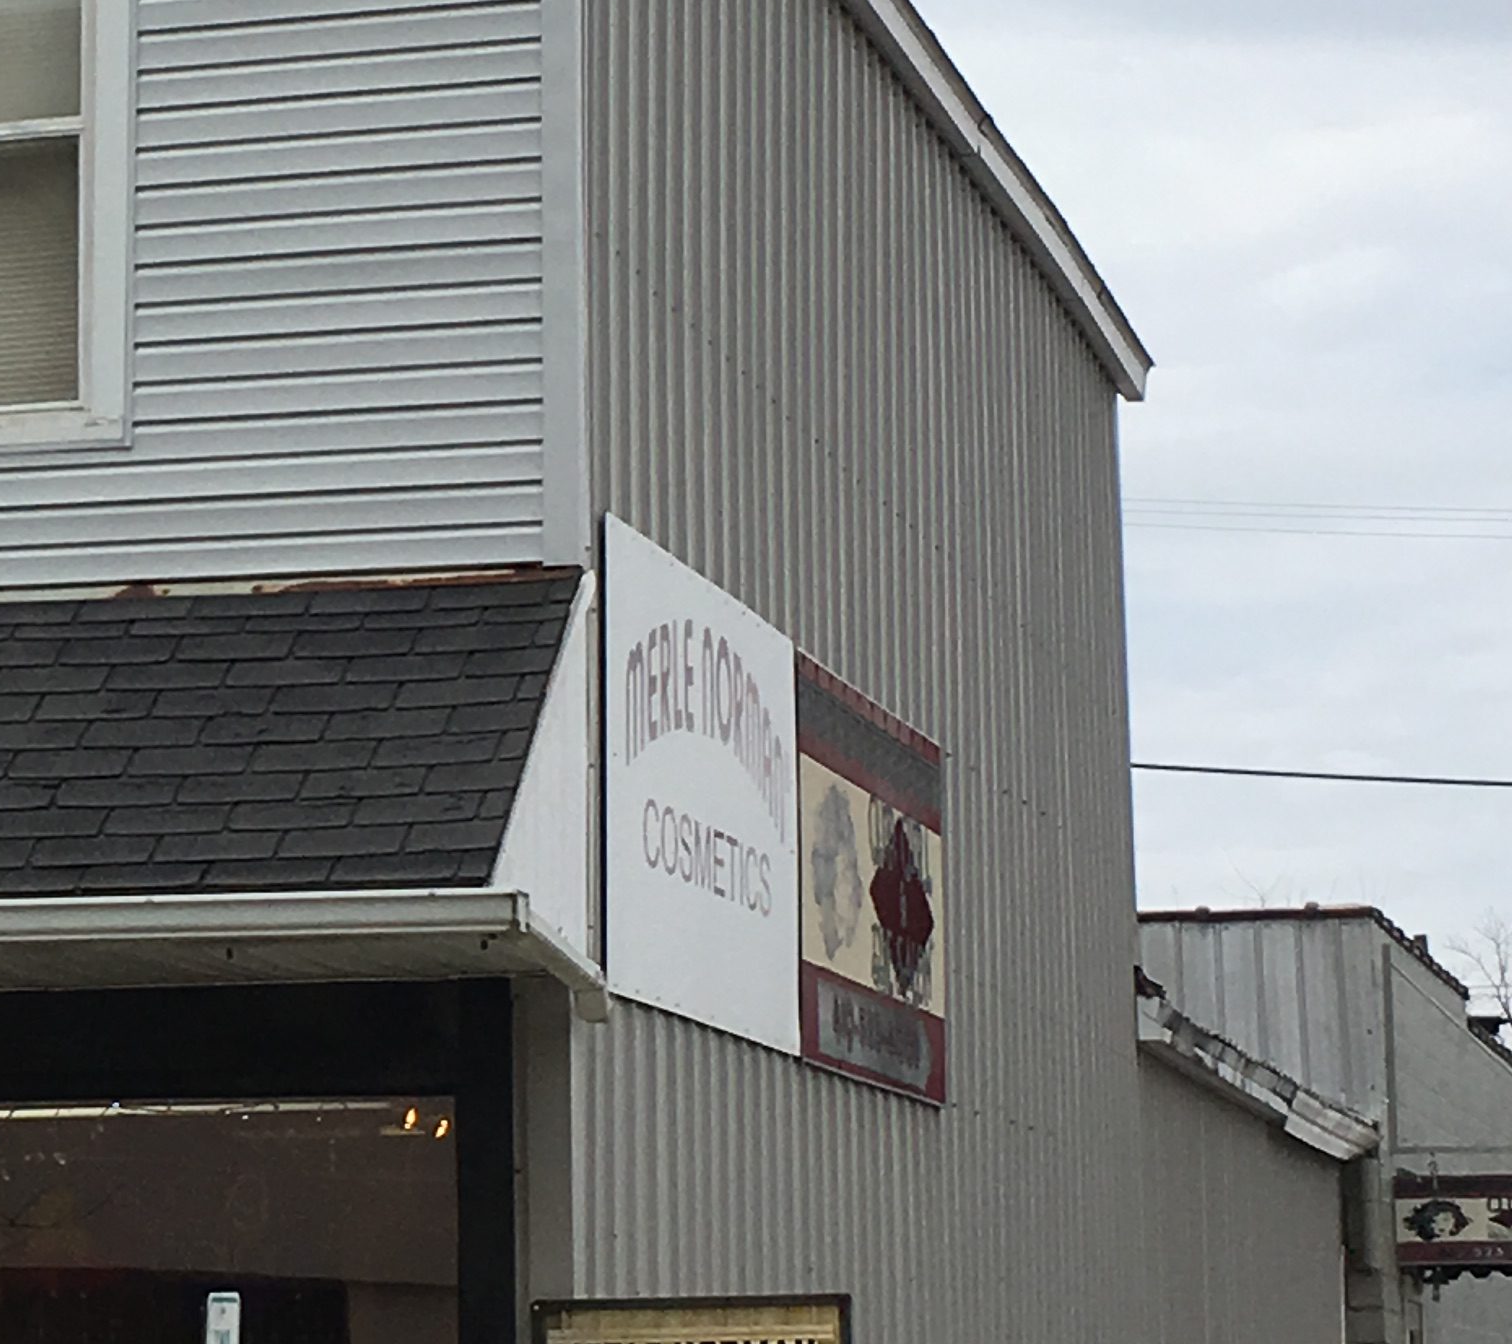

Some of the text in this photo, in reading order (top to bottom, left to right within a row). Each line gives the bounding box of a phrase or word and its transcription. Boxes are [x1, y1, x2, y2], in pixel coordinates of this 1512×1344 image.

[625, 617, 787, 844] MERLE NORMAN
[642, 798, 772, 917] COSMETICS
